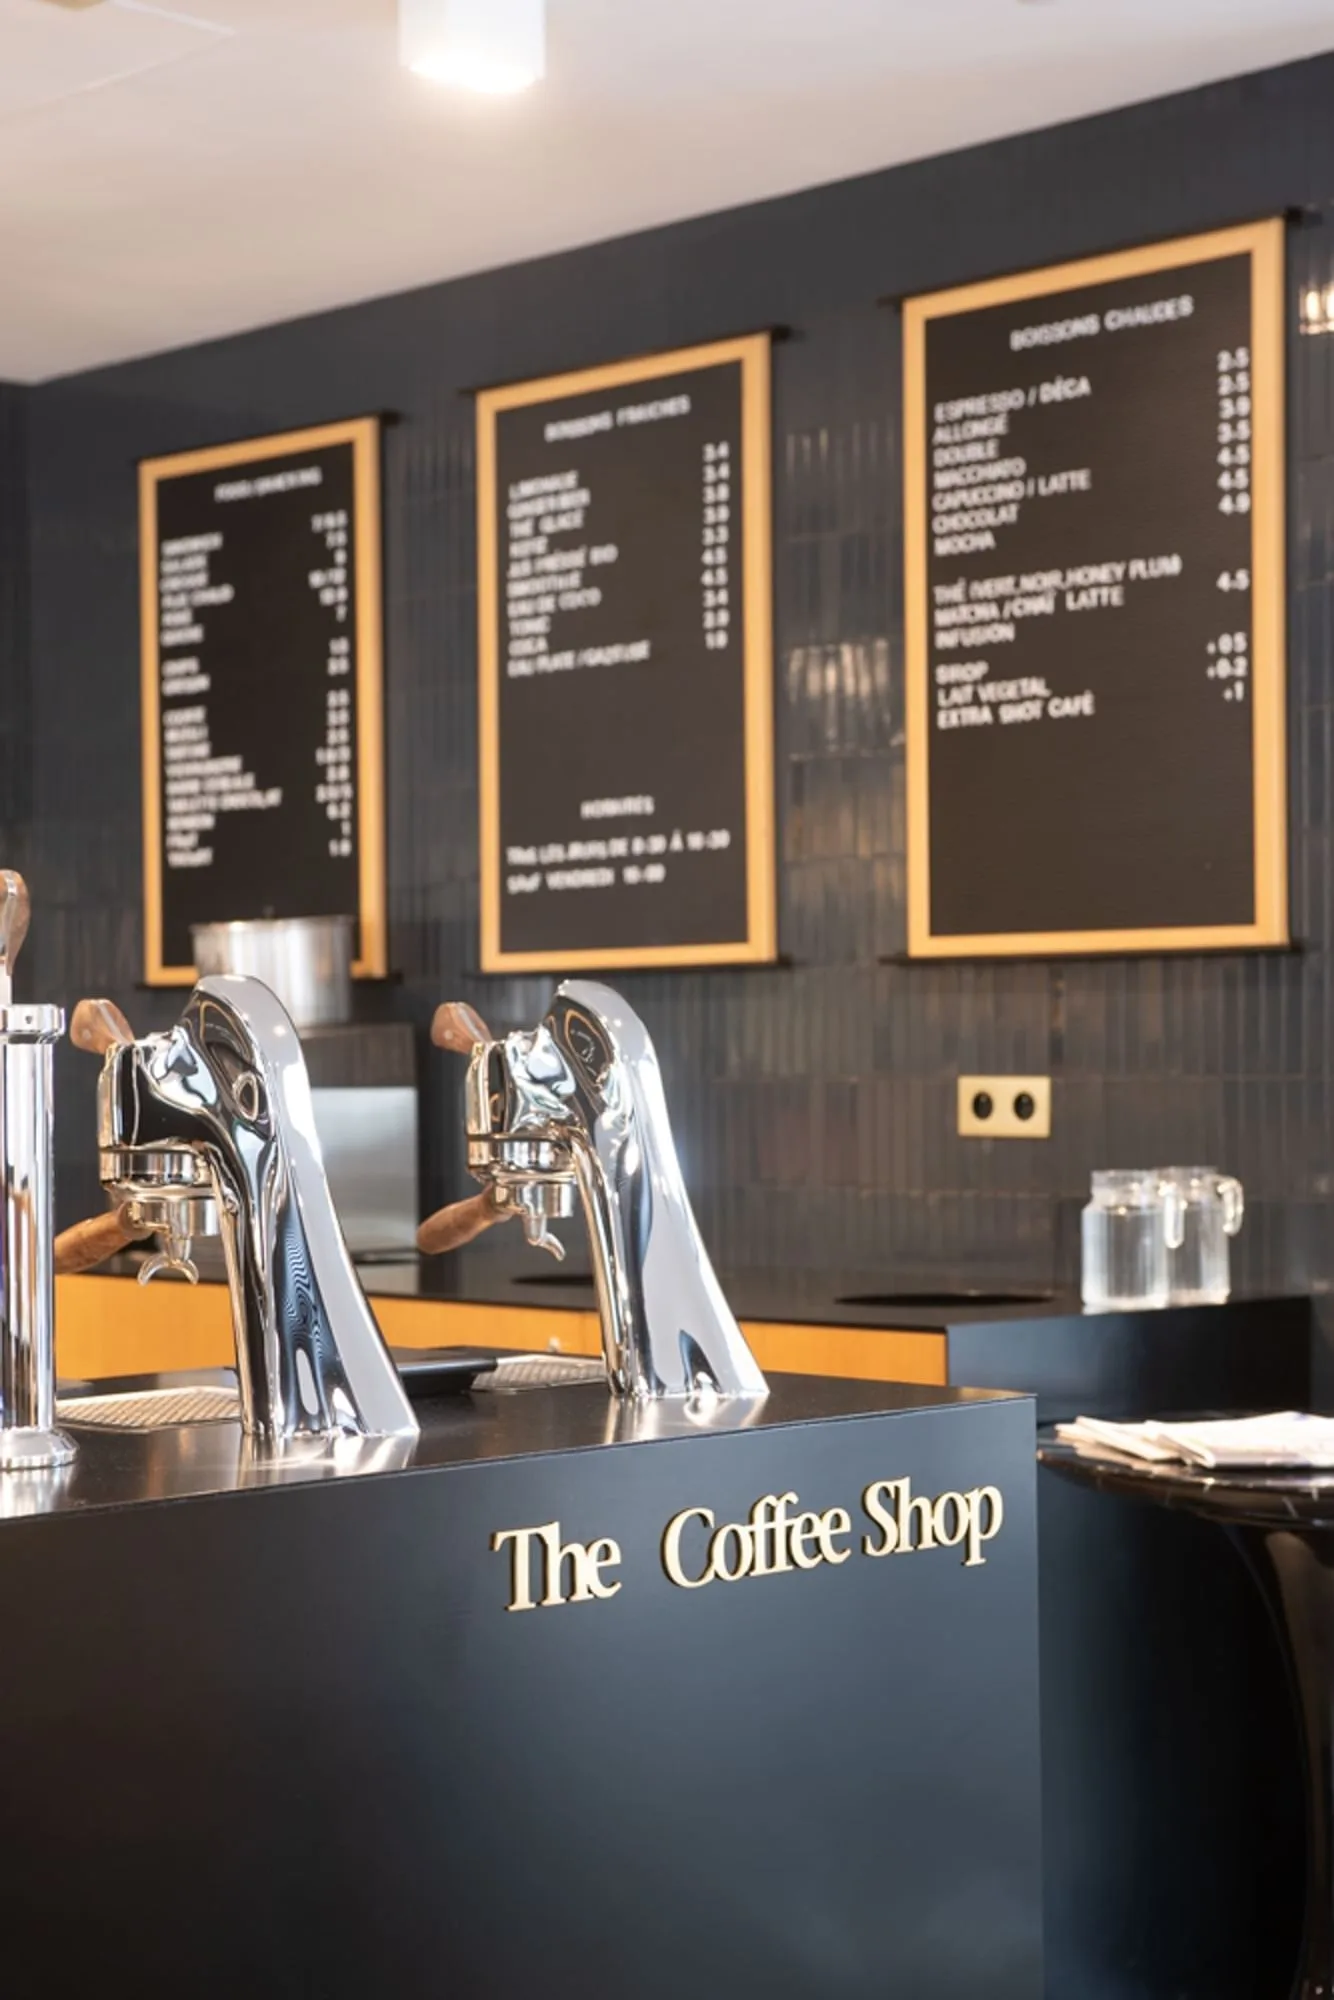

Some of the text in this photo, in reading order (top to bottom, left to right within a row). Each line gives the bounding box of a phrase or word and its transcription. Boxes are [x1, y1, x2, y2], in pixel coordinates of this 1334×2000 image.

[1010, 295, 1194, 351] BOISSONS CHAUDES
[934, 389, 1025, 423] ESPRESSO
[1039, 375, 1091, 403] DÉCA
[934, 439, 1000, 467] DOUBLE
[1038, 468, 1091, 497] LATTE
[933, 504, 1019, 535] CHOCOLAT
[934, 531, 996, 556] MOCHA
[1066, 584, 1125, 611] LATTE
[935, 622, 1015, 650] INFUSION
[936, 661, 989, 686] SIROP
[937, 681, 974, 708] LAIT
[937, 690, 1095, 729] EXTRA SHOT CAFÉ
[490, 1475, 1004, 1612] The Coffee Shop
